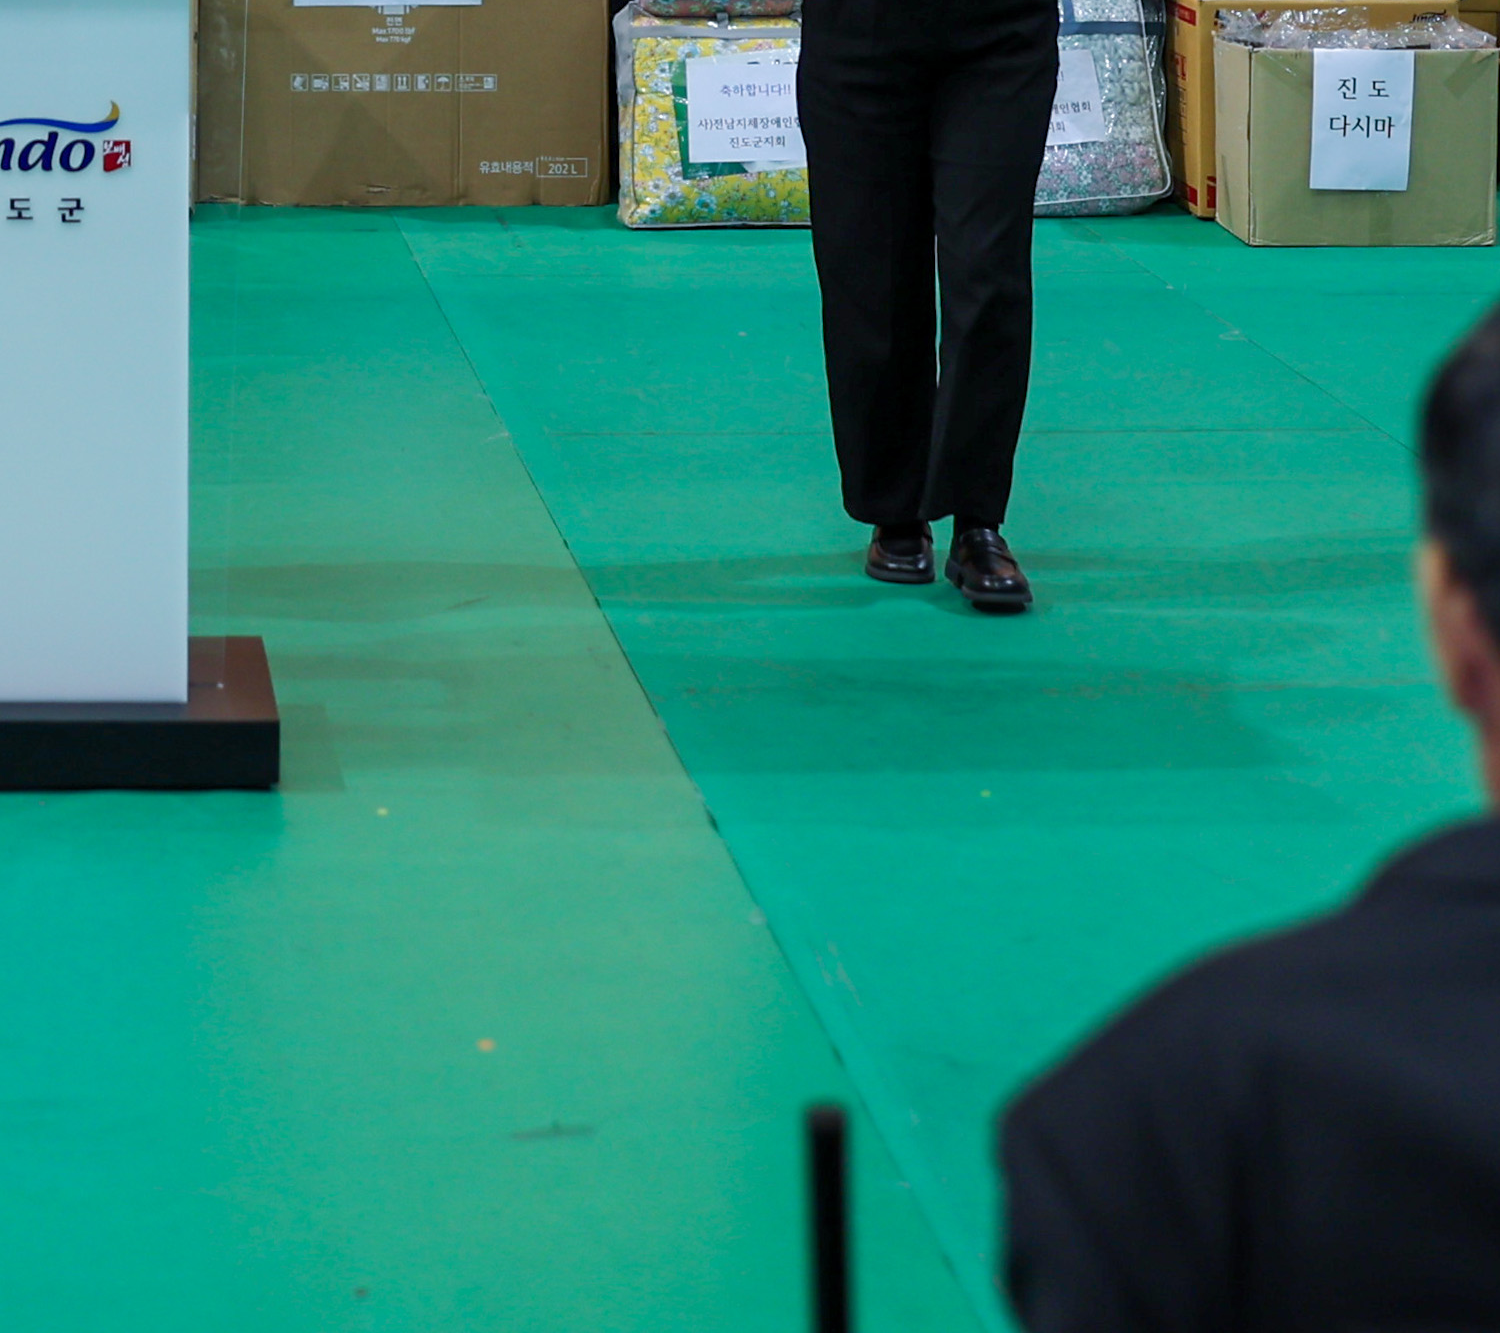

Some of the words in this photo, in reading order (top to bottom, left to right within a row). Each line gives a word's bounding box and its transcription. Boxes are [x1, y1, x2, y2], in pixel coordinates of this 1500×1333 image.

[1328, 115, 1397, 140] 다시마
[547, 162, 569, 175] 202
[570, 162, 578, 175] L
